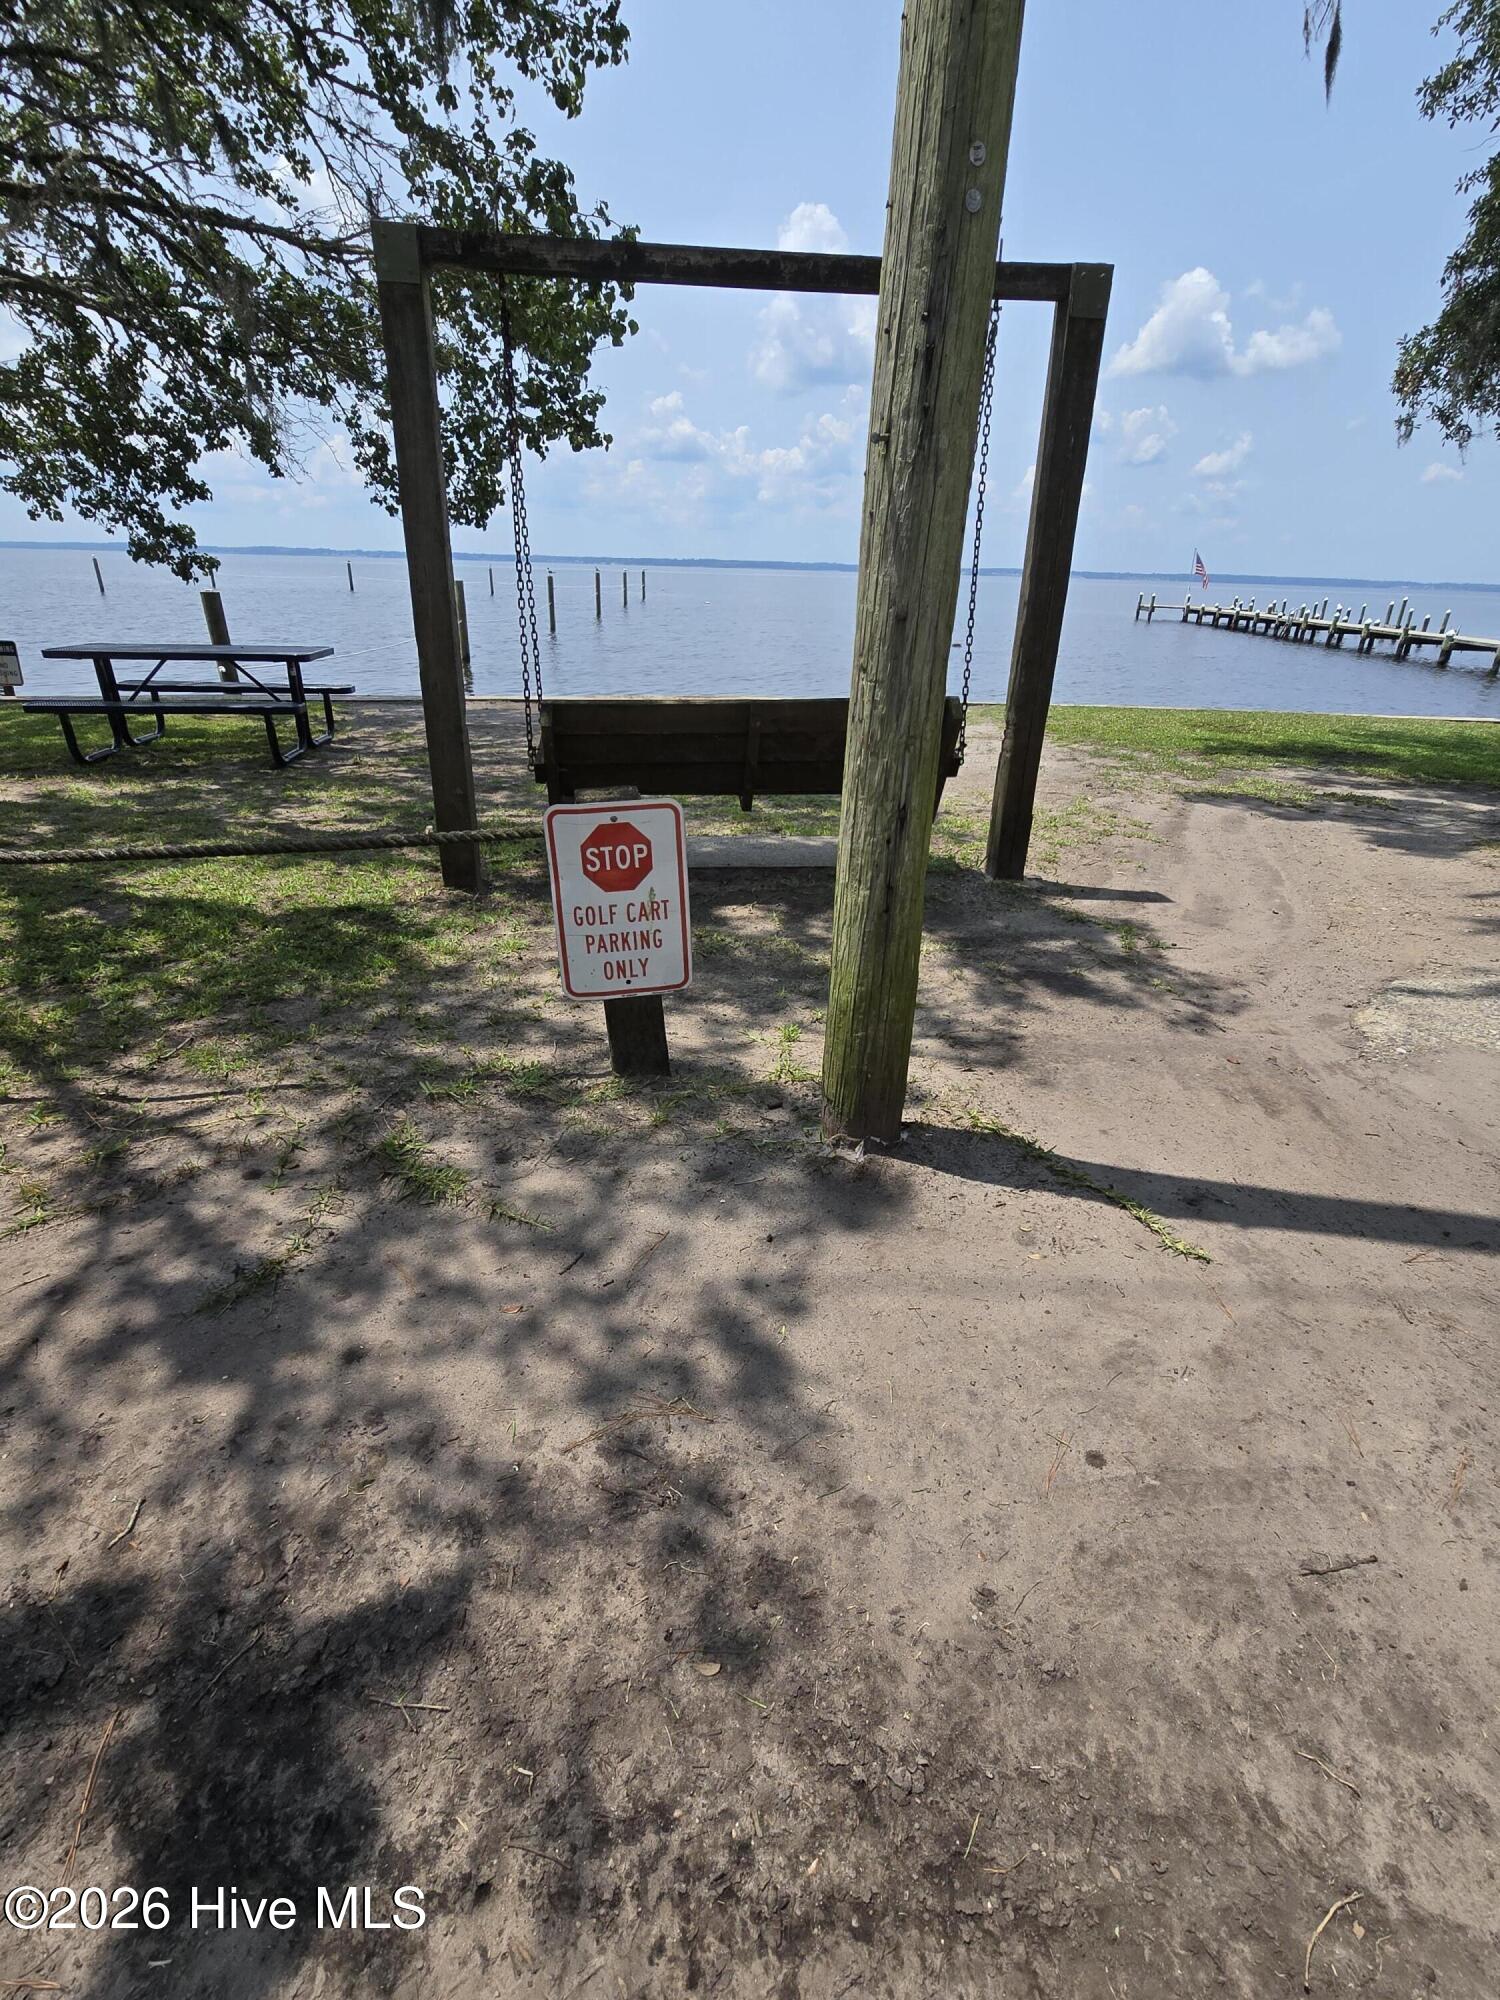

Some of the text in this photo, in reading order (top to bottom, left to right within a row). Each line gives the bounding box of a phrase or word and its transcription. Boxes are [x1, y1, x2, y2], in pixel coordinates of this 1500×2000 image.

[585, 844, 648, 872] STOP
[573, 900, 670, 926] GOLF CART
[585, 929, 663, 954] PARKING
[603, 957, 649, 980] ONLY
